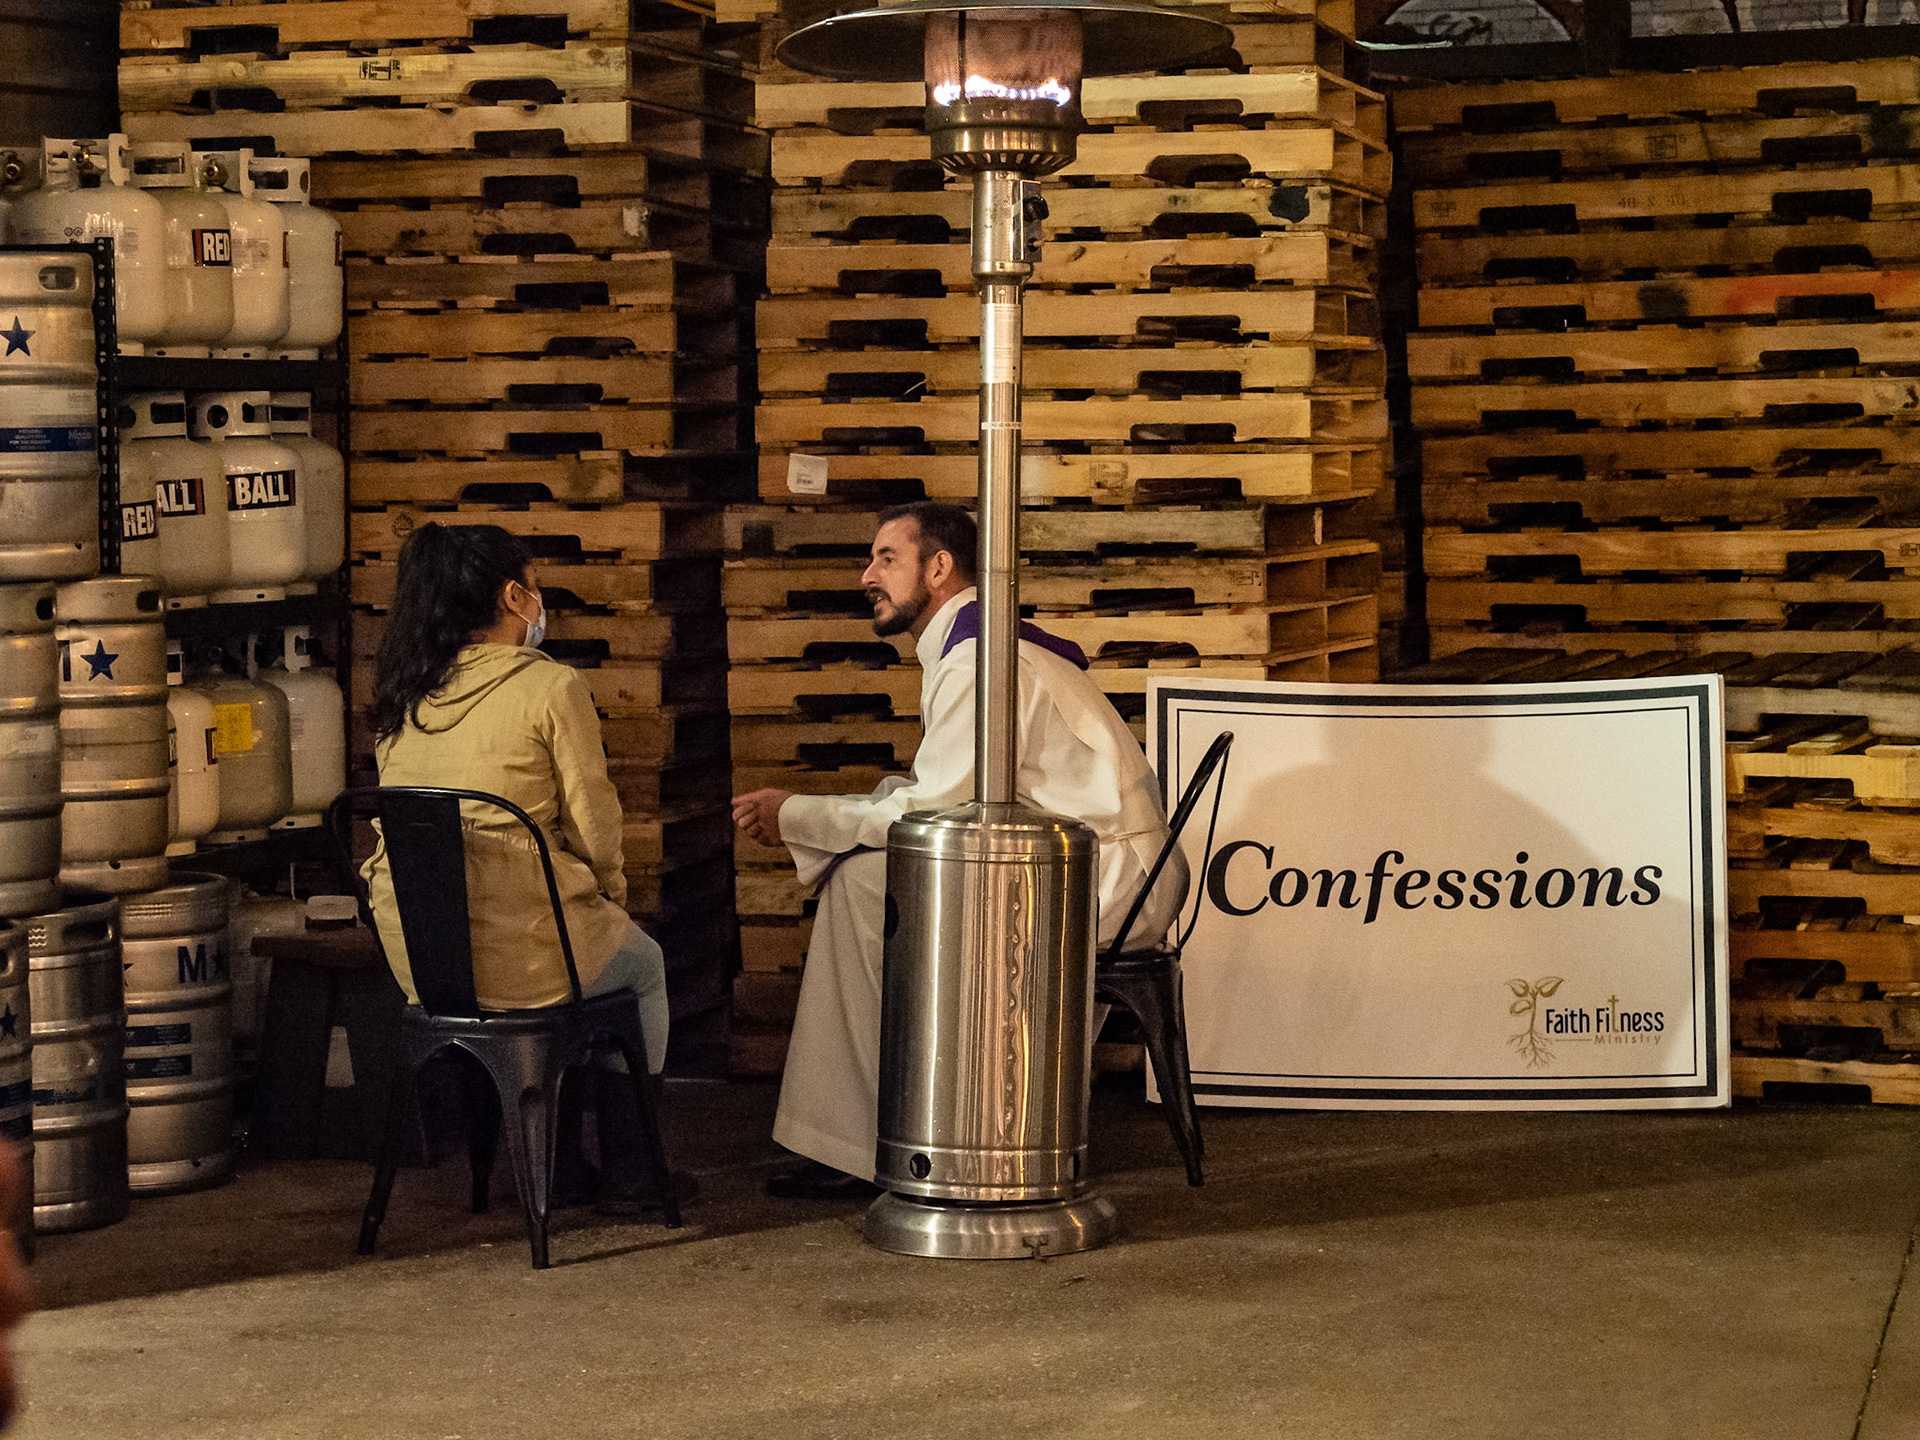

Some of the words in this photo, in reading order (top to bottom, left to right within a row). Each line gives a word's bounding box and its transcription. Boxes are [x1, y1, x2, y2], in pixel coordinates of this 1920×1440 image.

[202, 232, 231, 261] RED
[156, 482, 195, 512] ALL
[234, 474, 289, 505] BALL
[121, 504, 155, 537] RED
[1206, 840, 1663, 924] Confessions
[1546, 1007, 1590, 1033] Faith
[1596, 995, 1664, 1033] Fitness
[1594, 1033, 1661, 1045] Ministry
